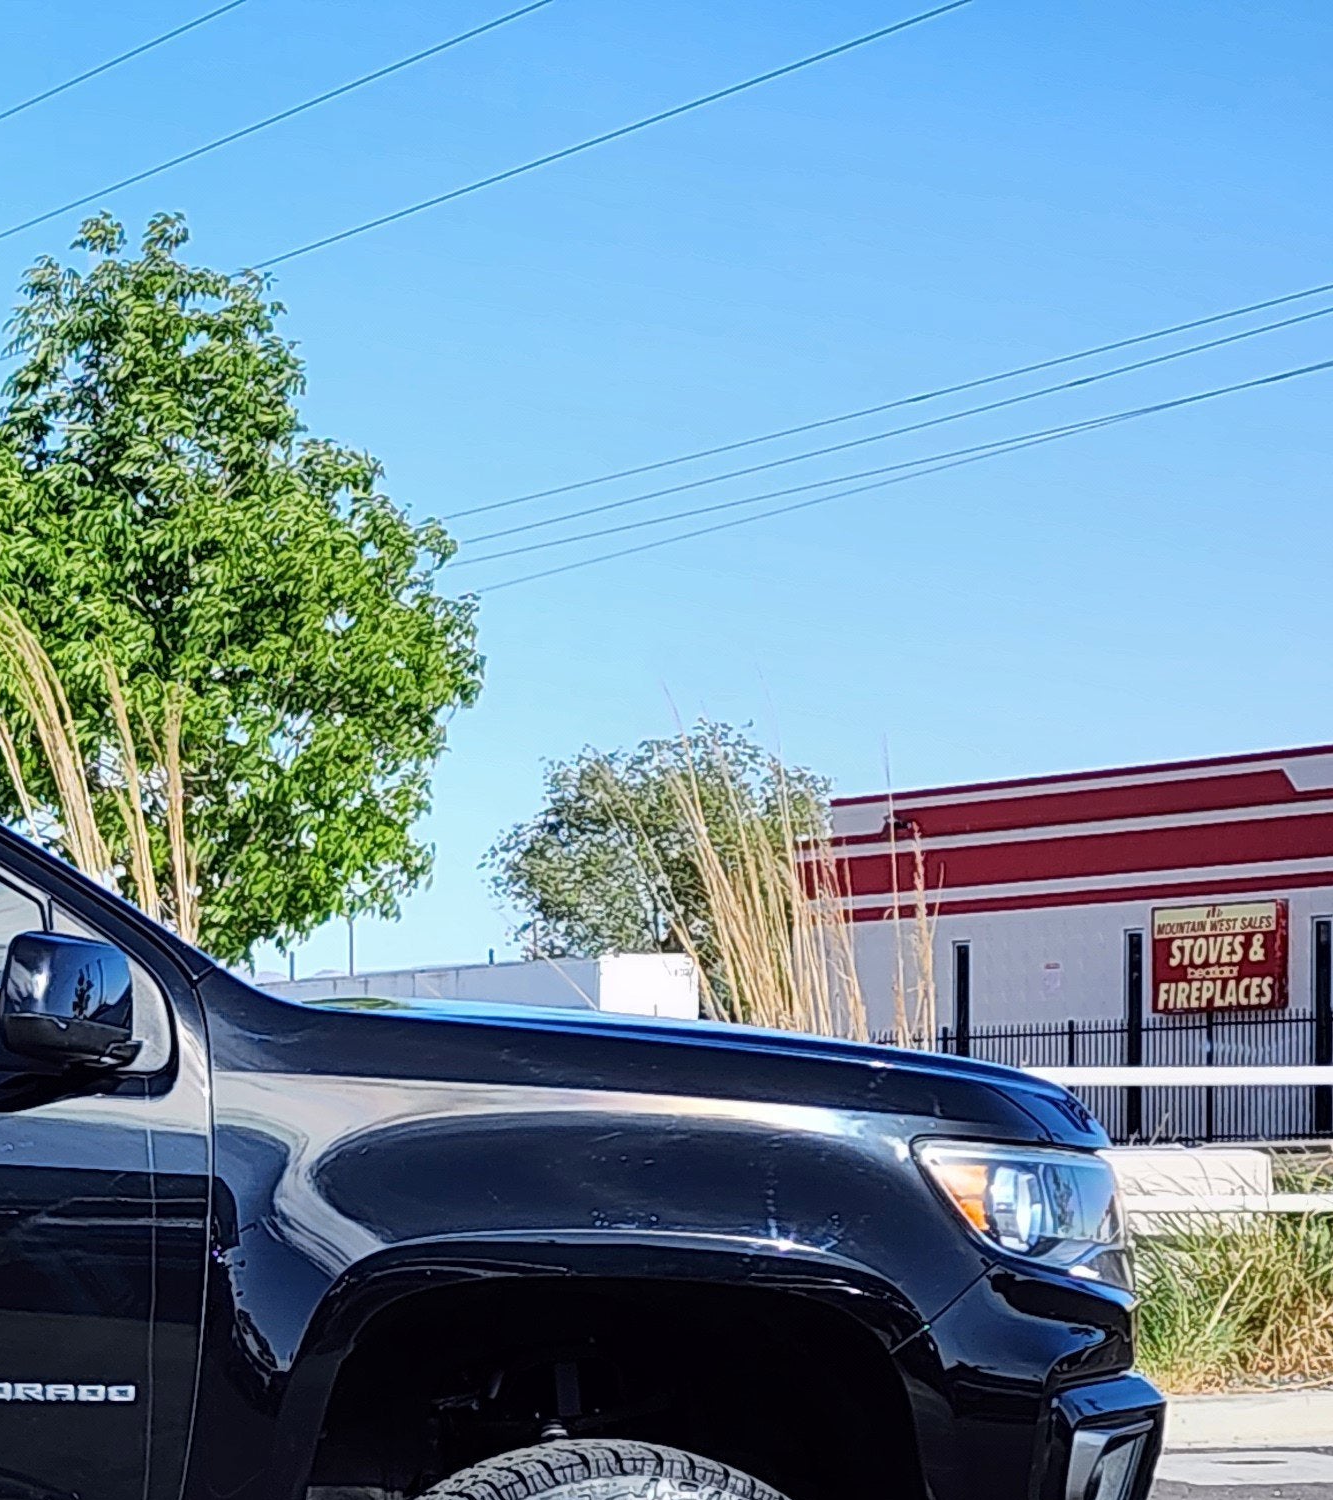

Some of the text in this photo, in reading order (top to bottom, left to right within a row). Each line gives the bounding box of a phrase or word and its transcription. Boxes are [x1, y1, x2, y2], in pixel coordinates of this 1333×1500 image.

[1157, 915, 1272, 935] MOUNTAIN WEST SALES
[1169, 933, 1265, 967] STOVES &
[1157, 976, 1274, 1010] FIREPLACES
